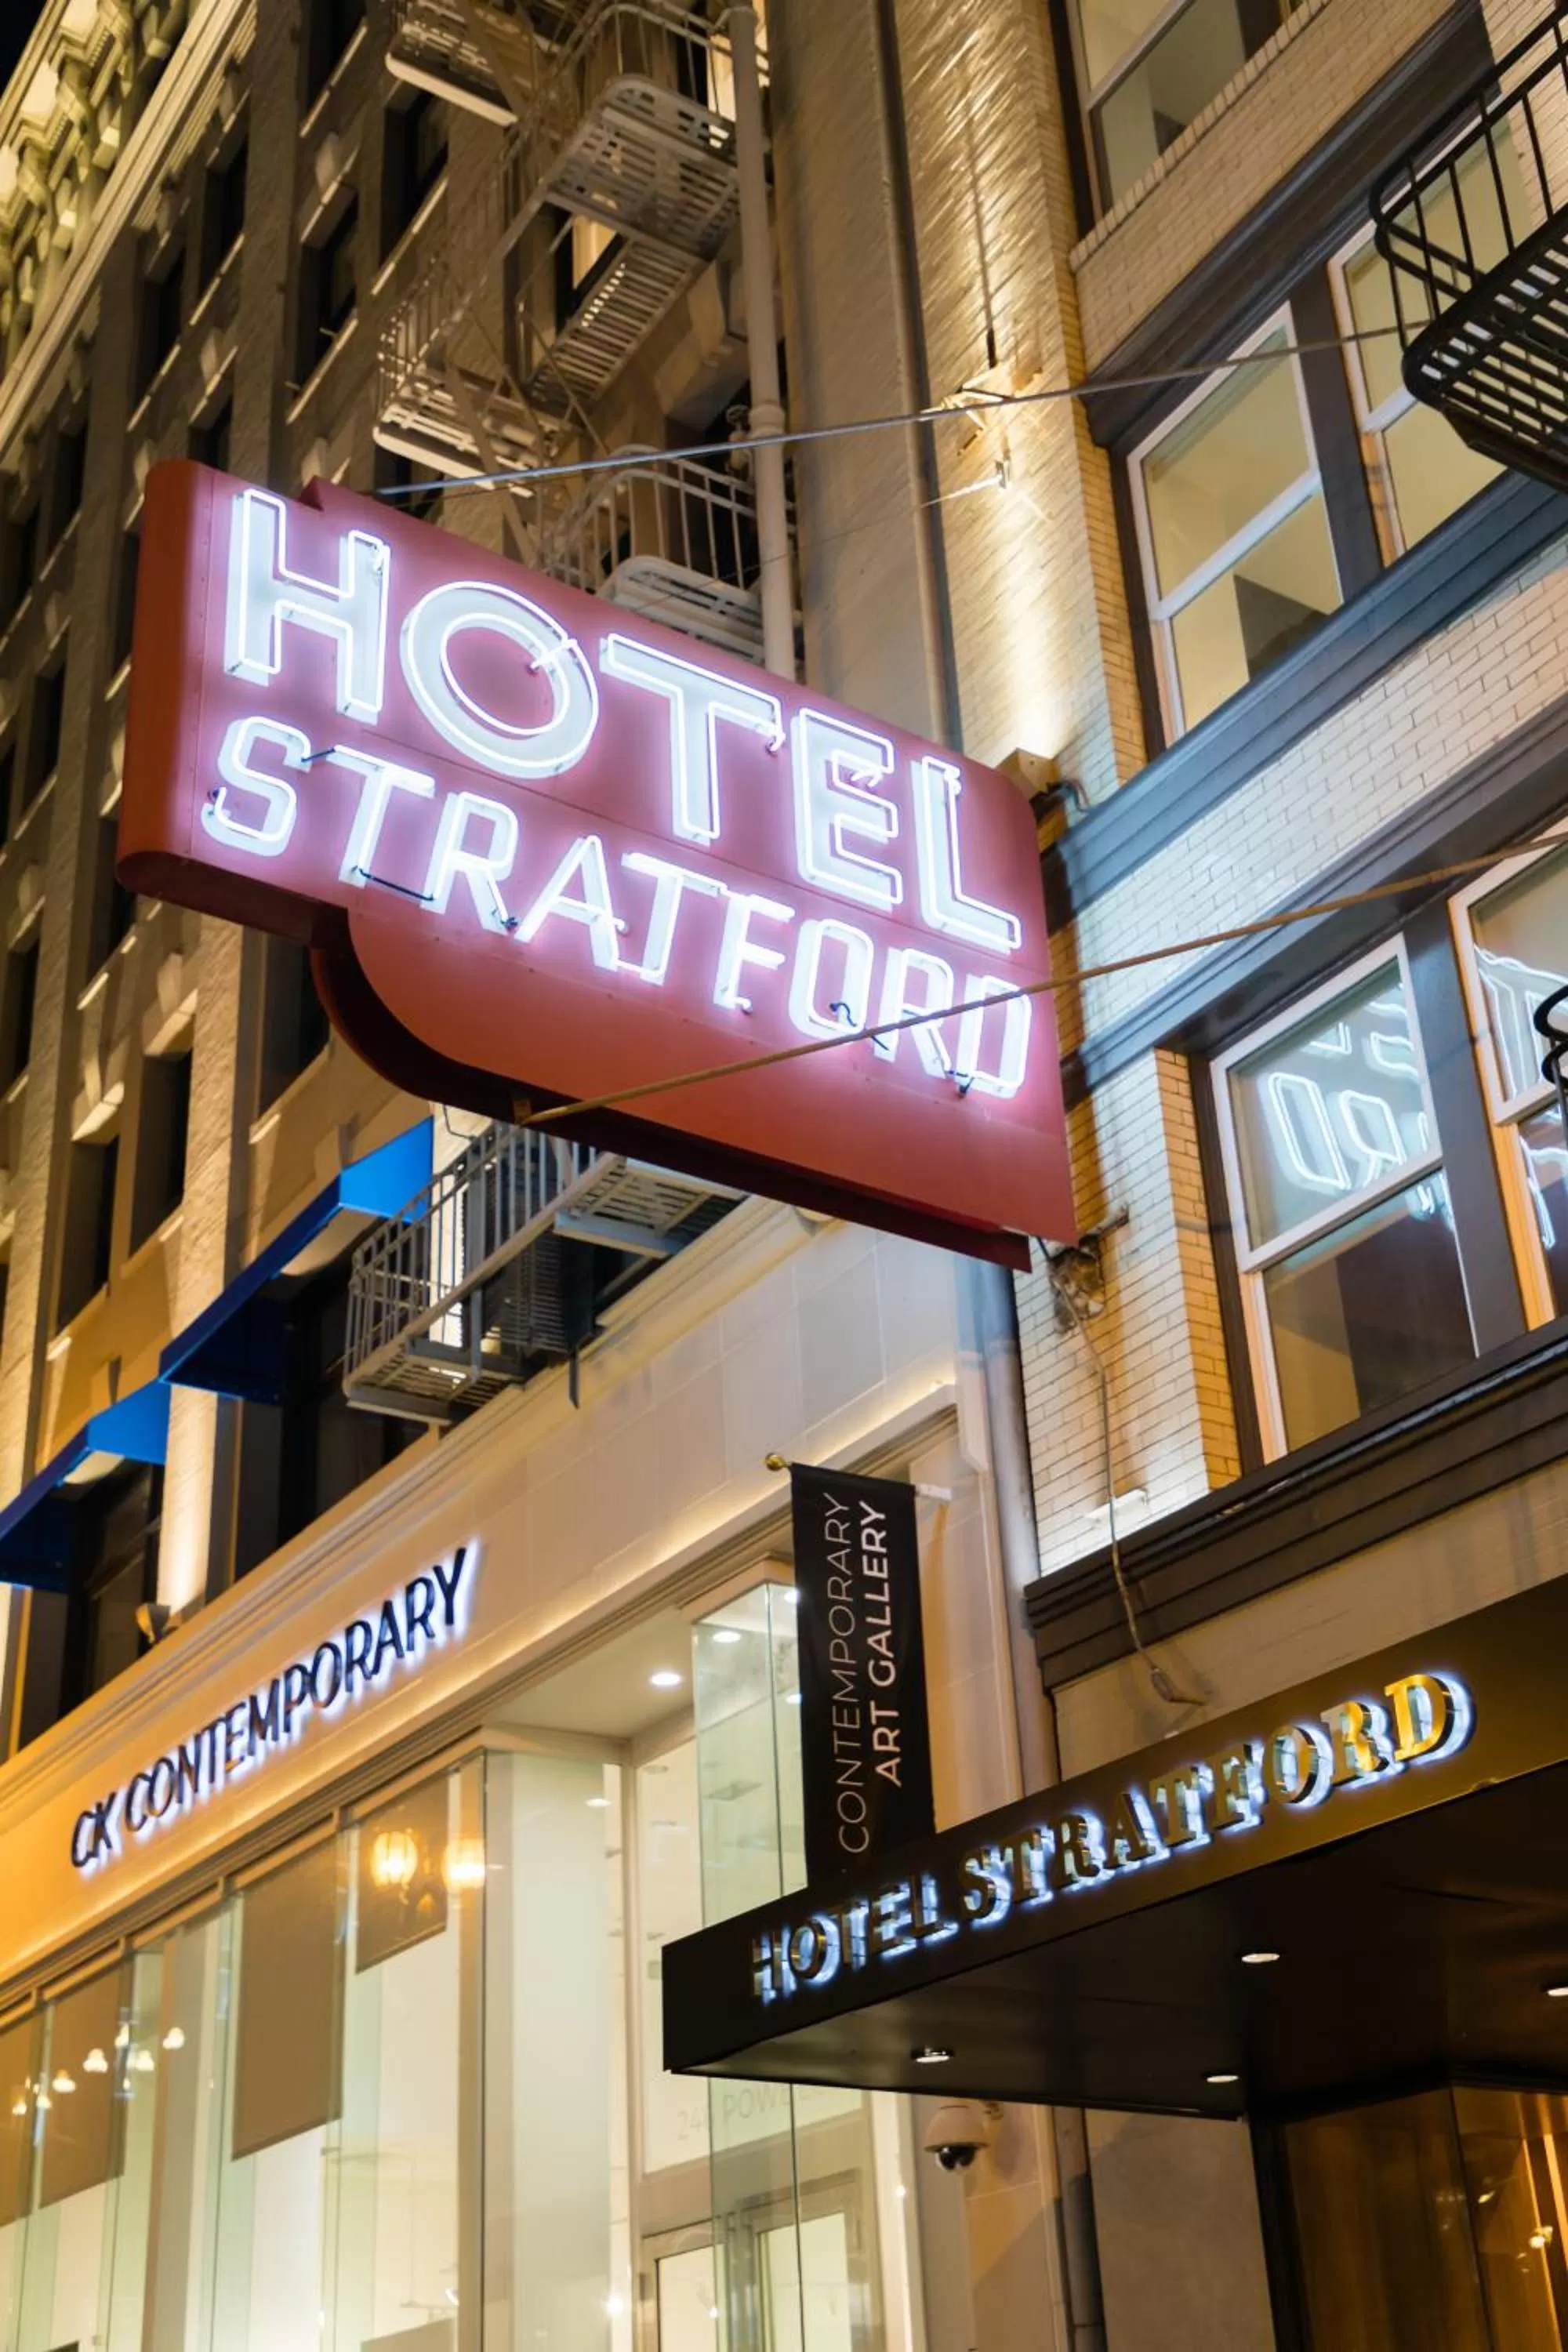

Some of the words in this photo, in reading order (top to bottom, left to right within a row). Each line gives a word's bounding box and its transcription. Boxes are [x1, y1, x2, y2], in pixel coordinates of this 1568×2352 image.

[223, 488, 1022, 949] HOTEL
[201, 716, 1033, 1097] STRATFORD
[71, 1791, 118, 1868] CK
[125, 1547, 467, 1833] CONTEMPORARY
[824, 1492, 869, 1854] CONTEMPORARY
[858, 1500, 896, 1686] GALLERY
[870, 1700, 902, 1788] ART
[751, 1871, 960, 2002] HOTEL
[958, 1672, 1469, 1929] STRATFORD
